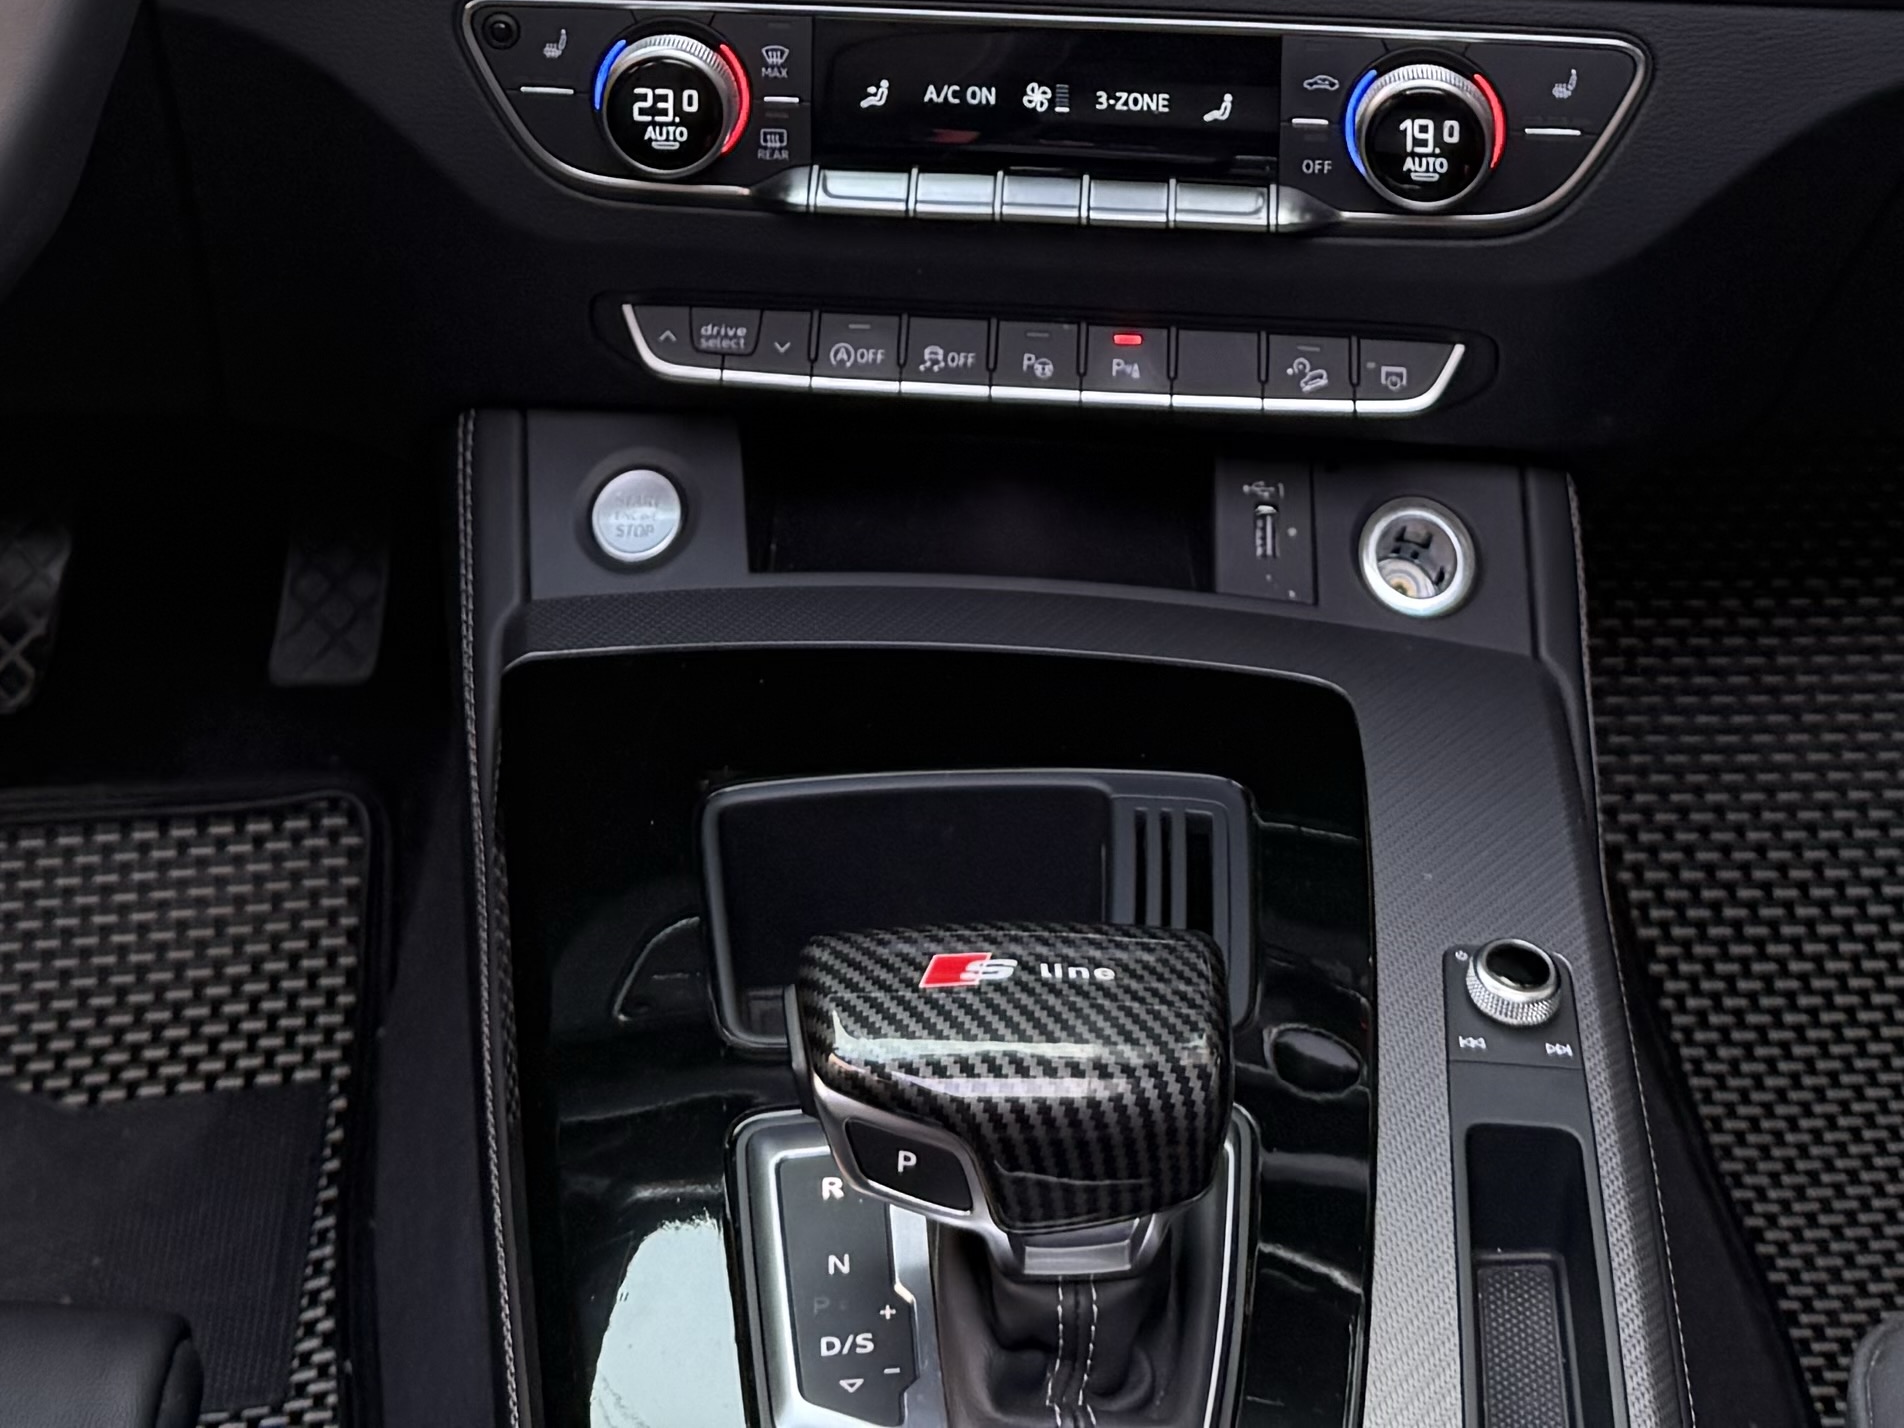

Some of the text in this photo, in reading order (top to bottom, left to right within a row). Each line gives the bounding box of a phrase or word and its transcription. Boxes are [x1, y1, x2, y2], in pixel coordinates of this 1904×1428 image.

[761, 66, 789, 79] MAX
[923, 83, 997, 106] A/C ON
[1095, 90, 1171, 114] 3-ZONE
[632, 87, 700, 123] 23.0
[644, 125, 689, 142] AUTO
[1399, 118, 1461, 155] 19.0
[757, 147, 790, 161] REAR
[1301, 159, 1333, 174] OFF
[1402, 156, 1450, 174] AUTO
[700, 322, 748, 338] drive
[700, 336, 747, 351] select
[856, 348, 886, 365] OFF
[947, 351, 977, 368] OFF
[615, 523, 656, 539] STOP
[1039, 961, 1116, 982] line
[897, 1150, 918, 1174] P
[821, 1176, 845, 1200] R
[828, 1253, 851, 1276] N
[820, 1332, 876, 1357] D/S
